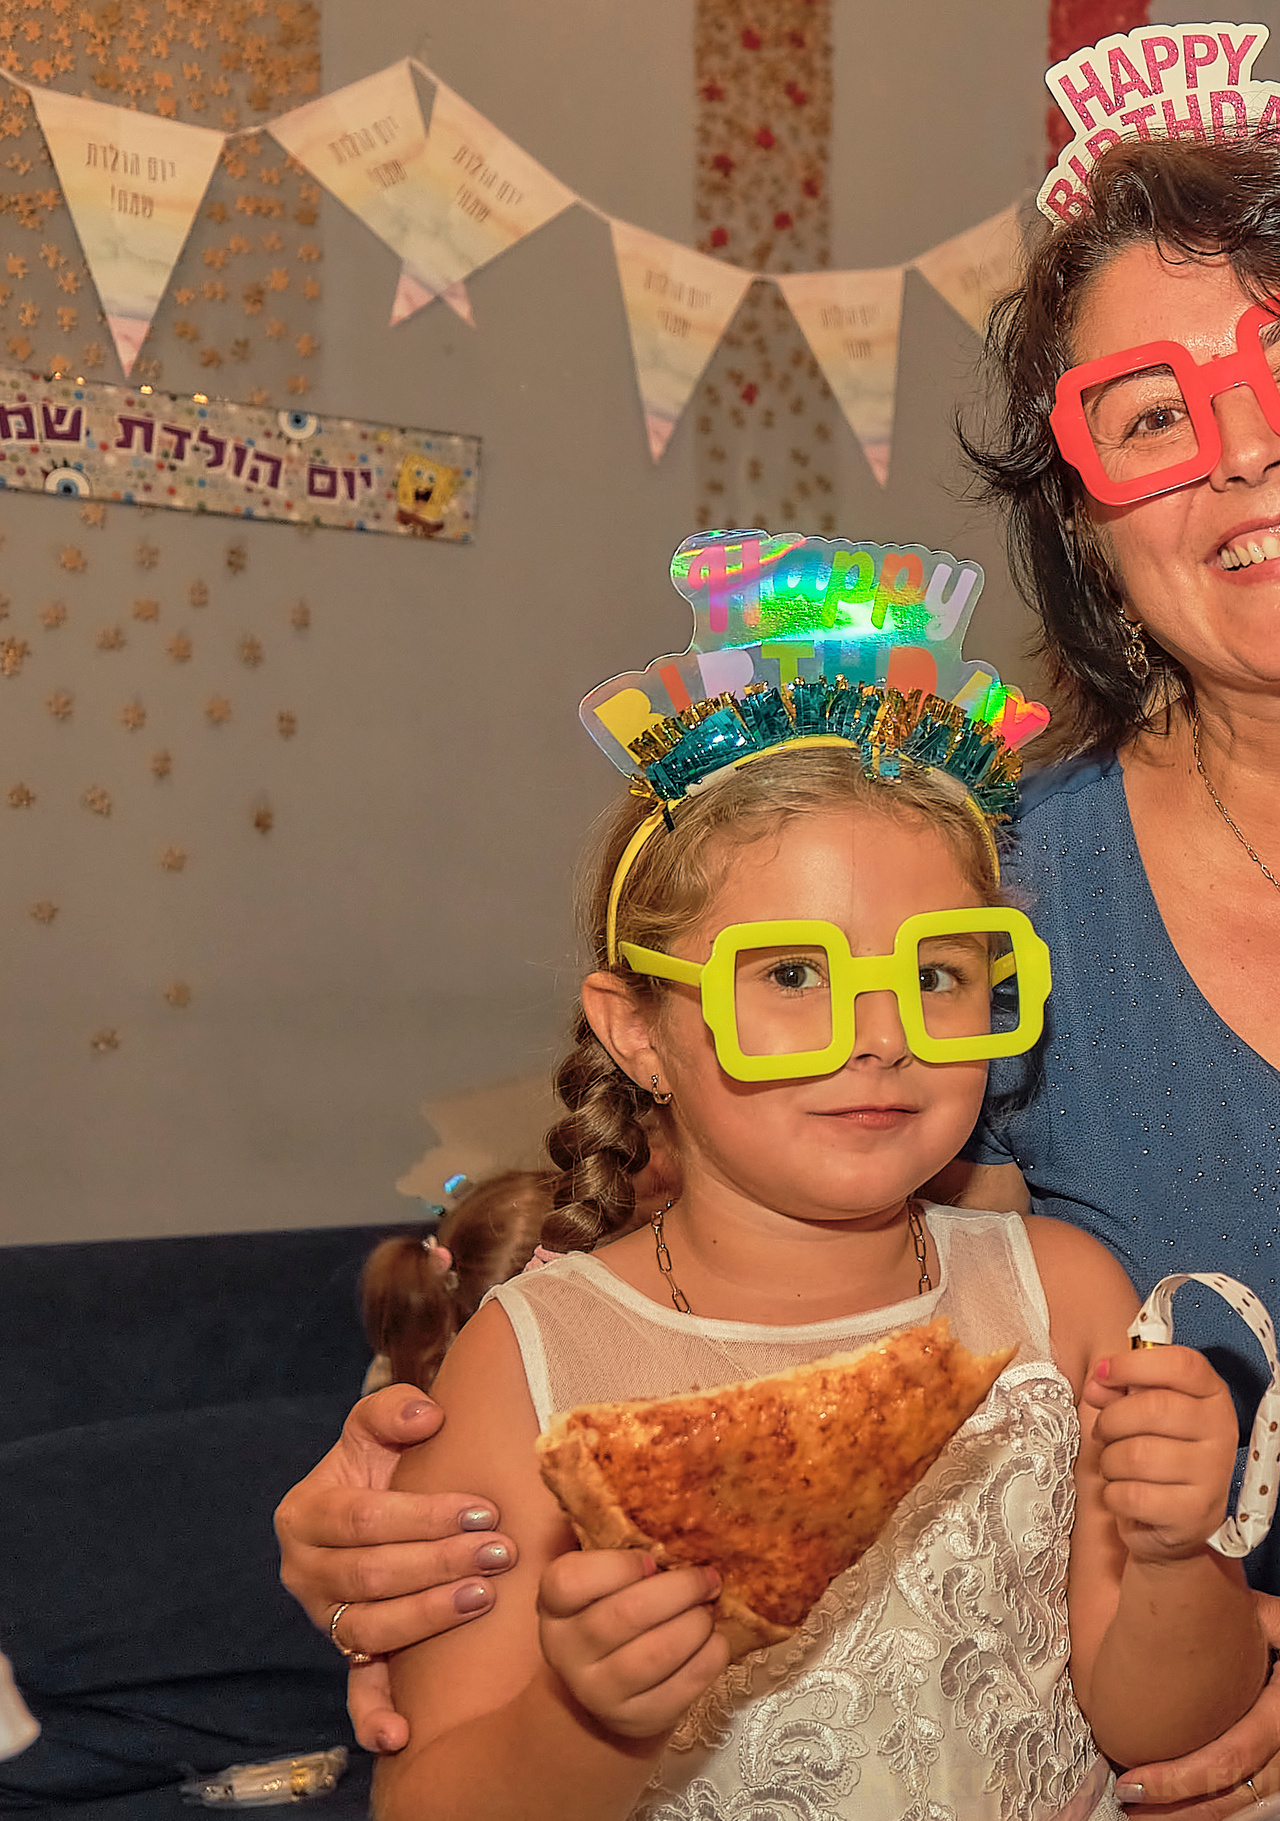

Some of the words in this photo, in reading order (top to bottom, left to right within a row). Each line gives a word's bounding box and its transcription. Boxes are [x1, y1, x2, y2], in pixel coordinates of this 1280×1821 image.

[1058, 33, 1258, 131] HAPPY
[86, 142, 140, 175] הולדת
[147, 157, 176, 181] יום
[115, 414, 283, 491] הולדת
[308, 466, 373, 501] יום
[688, 538, 978, 641] Happy
